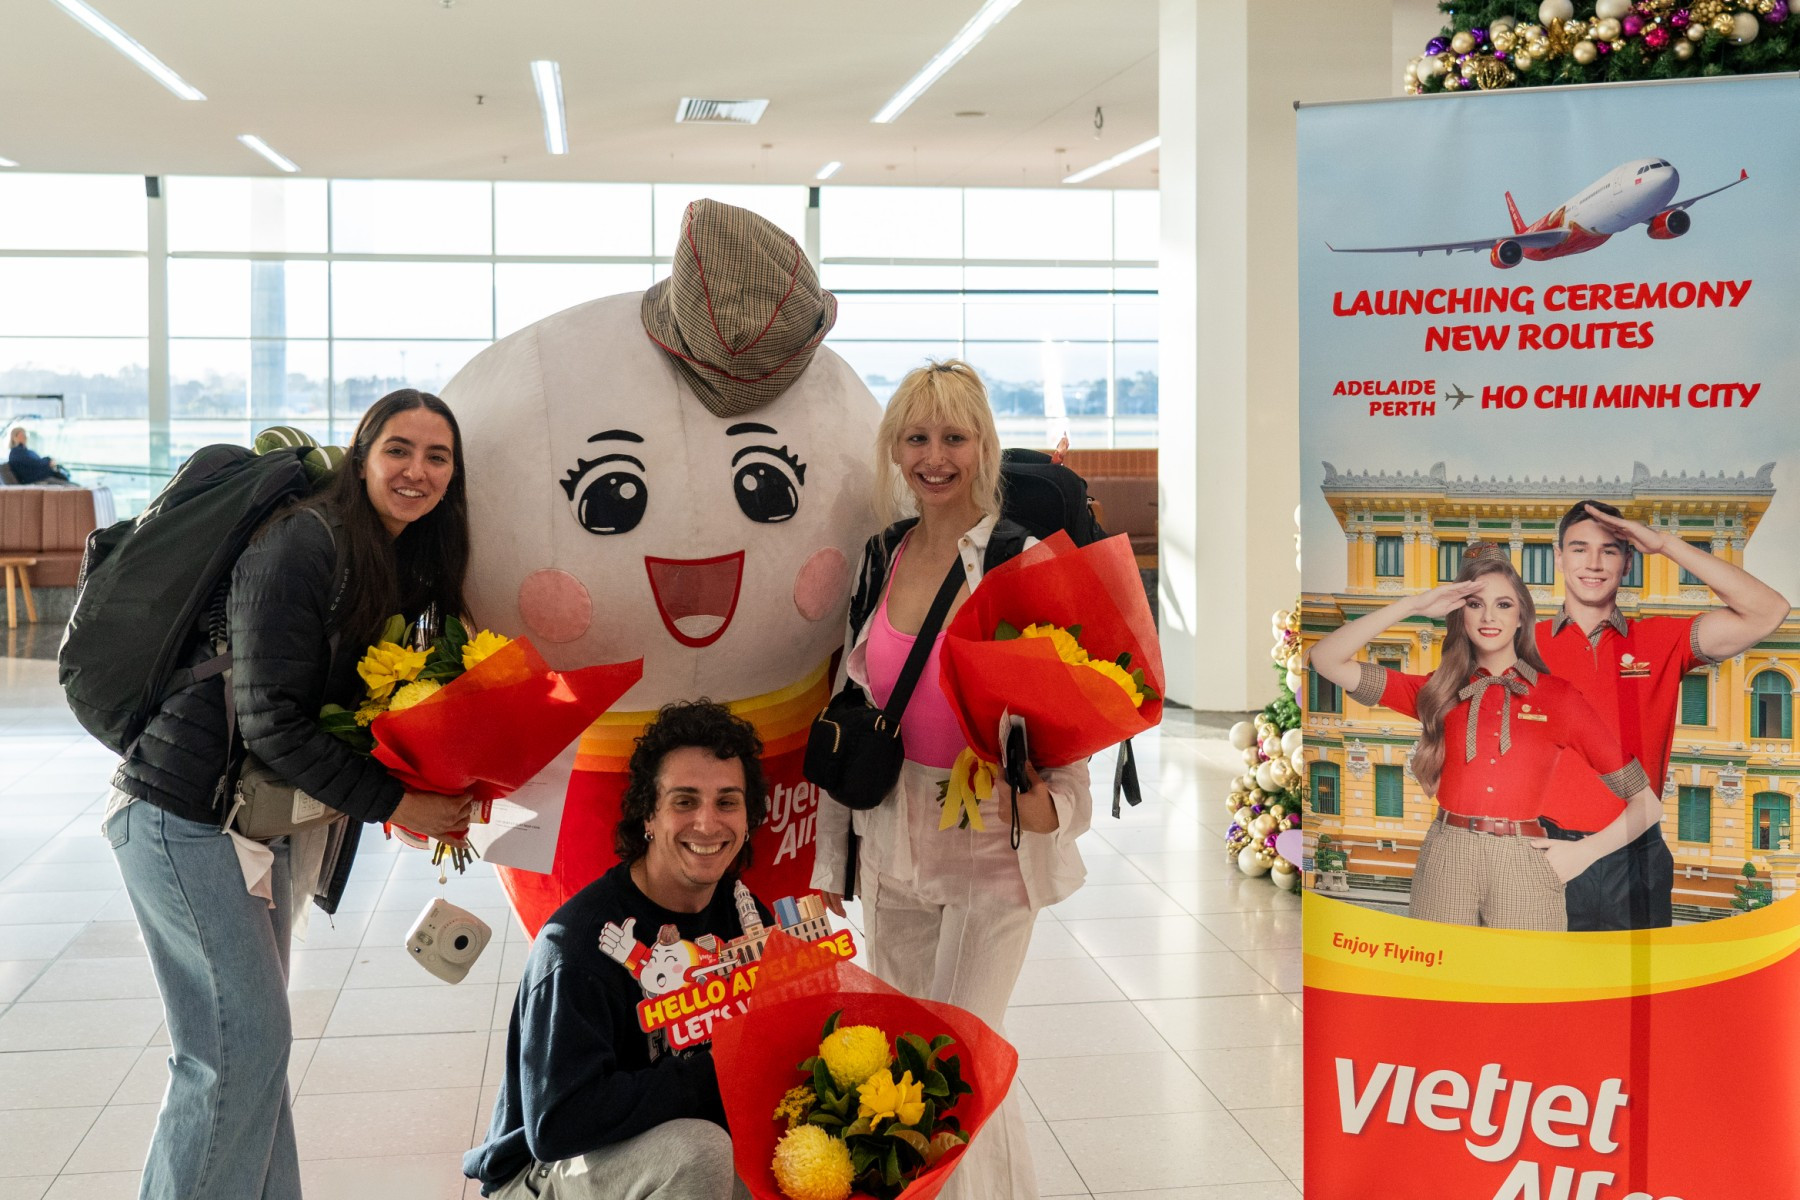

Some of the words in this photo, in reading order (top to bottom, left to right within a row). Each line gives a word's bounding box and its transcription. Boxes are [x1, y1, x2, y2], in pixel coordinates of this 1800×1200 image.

[1332, 285, 1535, 317] LAUNCHING
[1543, 279, 1753, 313] CEREMONY
[1424, 324, 1511, 353] NEW
[1517, 320, 1655, 351] ROUTES
[1332, 379, 1436, 397] ADELAIDE
[1481, 384, 1529, 410] HO
[1533, 384, 1589, 410] CHI
[1592, 383, 1682, 409] MINH
[1687, 382, 1761, 409] CITY
[1368, 400, 1437, 417] PERTH
[1332, 931, 1380, 958] Enjoy
[1383, 941, 1444, 969] Flying!
[643, 980, 726, 1029] HELLO
